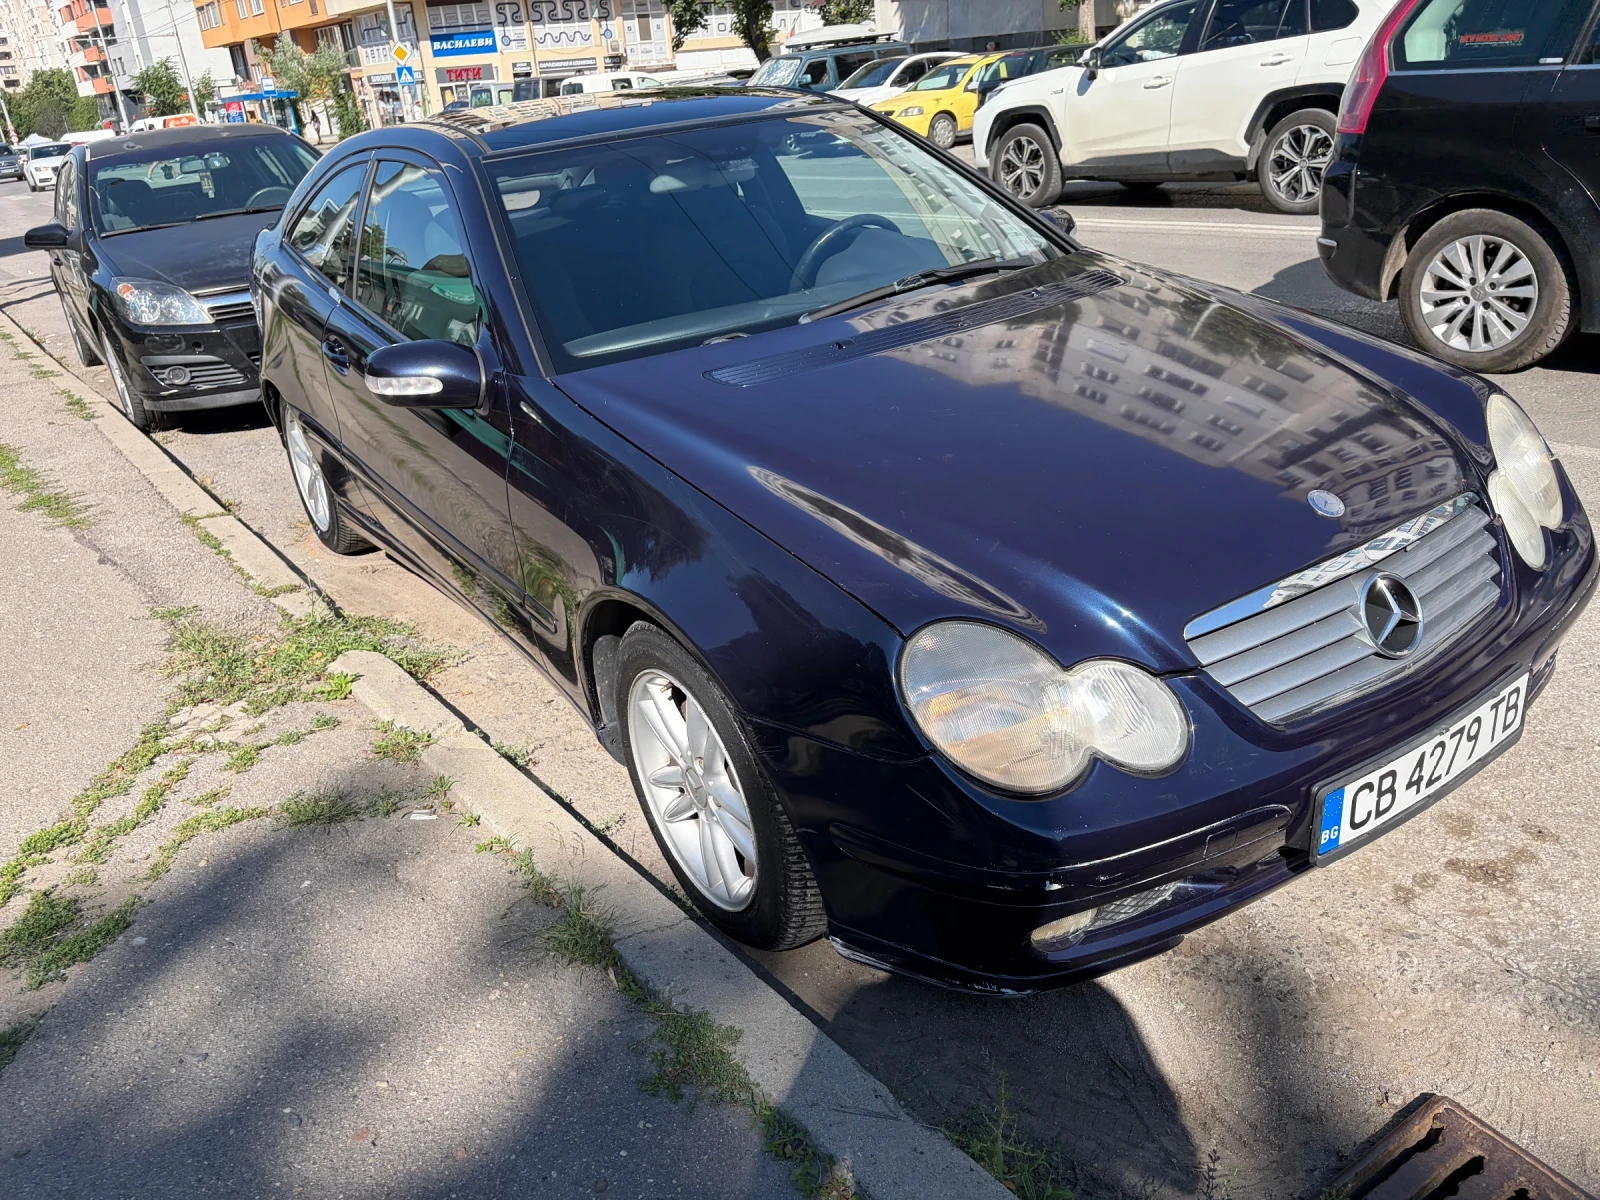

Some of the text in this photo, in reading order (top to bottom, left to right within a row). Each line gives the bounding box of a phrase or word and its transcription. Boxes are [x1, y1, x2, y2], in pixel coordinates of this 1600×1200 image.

[433, 37, 494, 51] ВАСИЛЕВИ
[446, 66, 482, 81] ТИТИ
[1349, 685, 1521, 831] CB 4279 TB
[1320, 824, 1340, 844] BG
